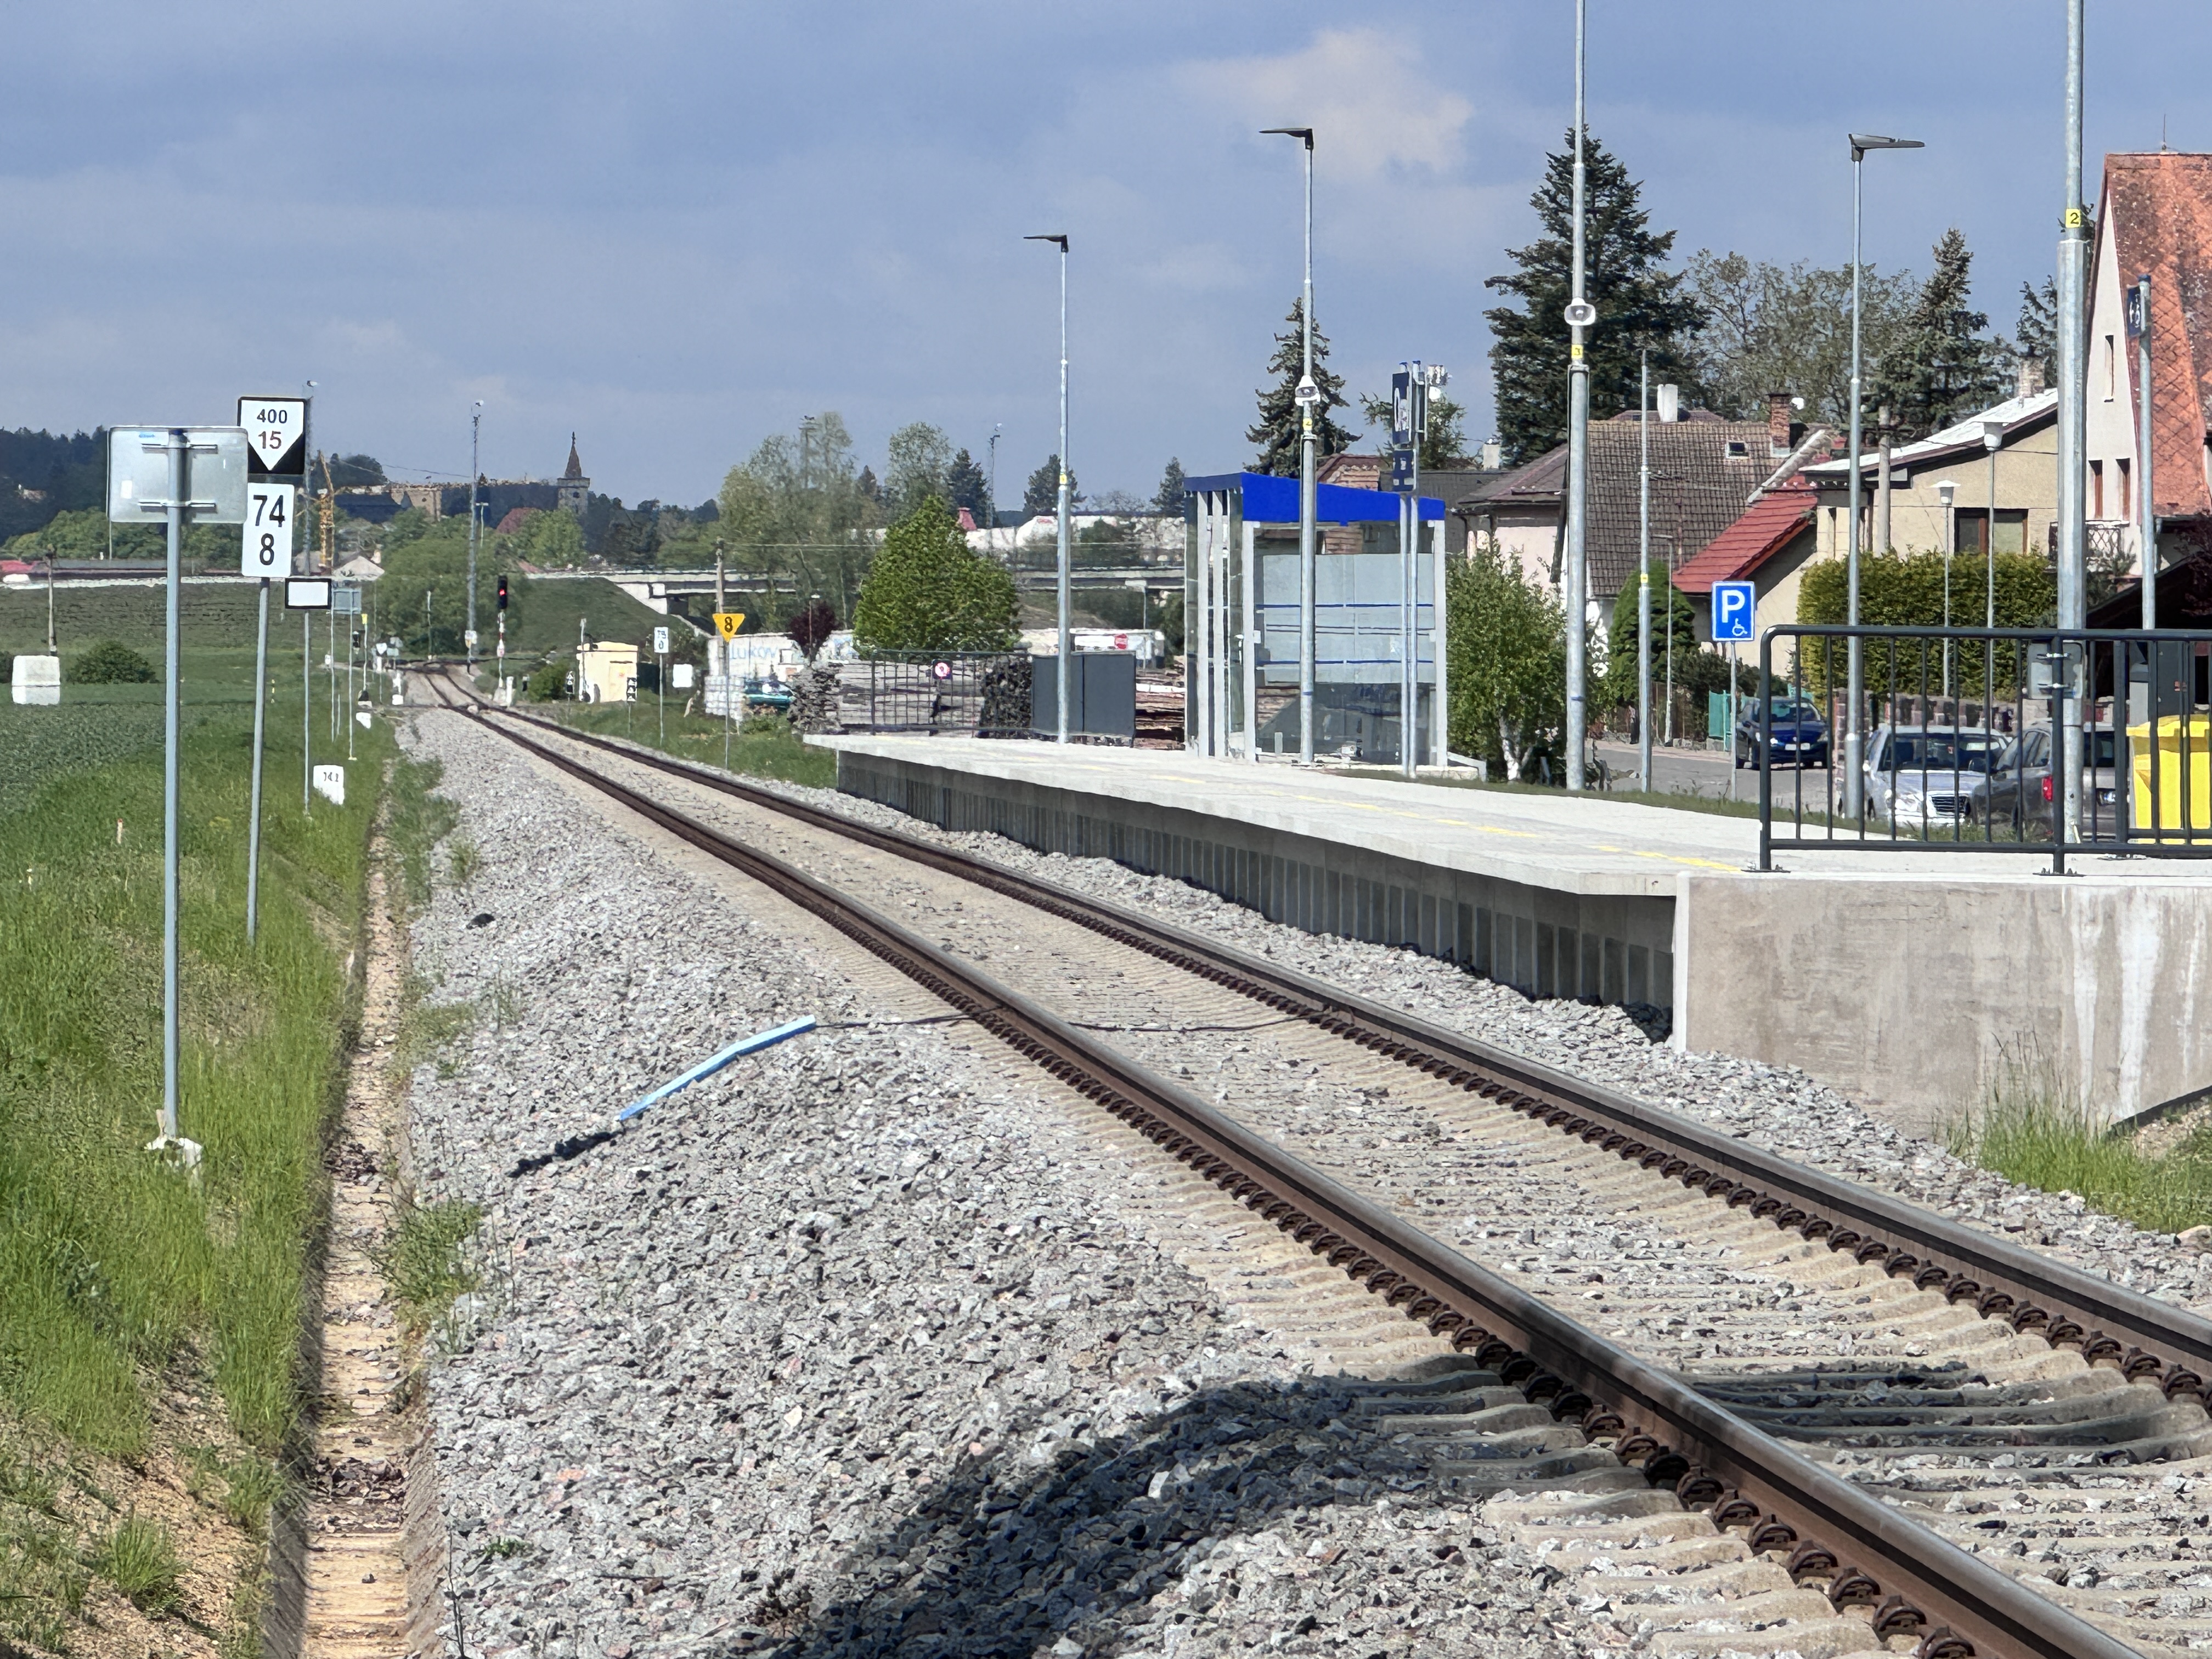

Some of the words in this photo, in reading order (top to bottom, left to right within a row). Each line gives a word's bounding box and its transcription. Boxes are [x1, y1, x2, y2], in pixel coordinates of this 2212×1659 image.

[2070, 212, 2079, 224] 2
[257, 409, 287, 424] 400
[258, 431, 281, 449] 15
[253, 495, 285, 527] 74
[259, 533, 274, 566] 8
[1722, 590, 1745, 623] P
[724, 616, 733, 632] 8
